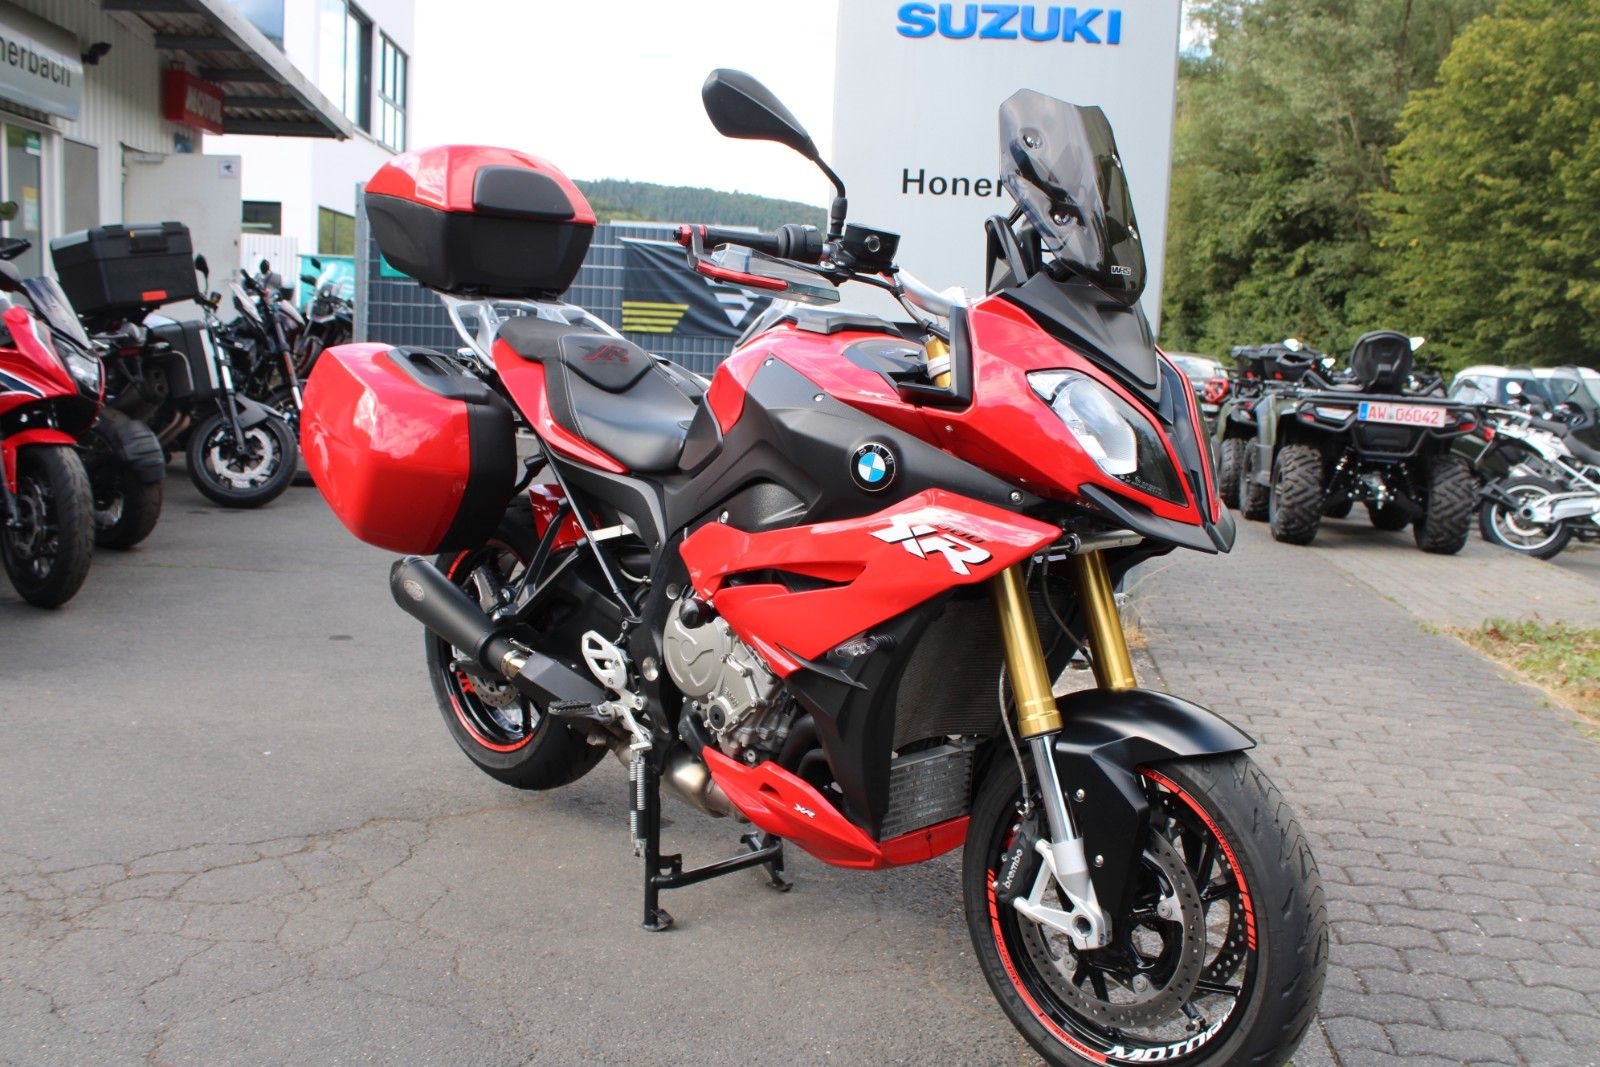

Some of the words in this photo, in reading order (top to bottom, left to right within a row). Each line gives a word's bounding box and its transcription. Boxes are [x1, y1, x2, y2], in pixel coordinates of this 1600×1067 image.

[896, 2, 1121, 45] SUZUKI
[1368, 405, 1387, 420] AW
[1395, 408, 1440, 425] 06042
[858, 444, 894, 465] BMW
[868, 510, 993, 577] XR
[793, 802, 816, 819] XR
[1002, 848, 1023, 890] brembo
